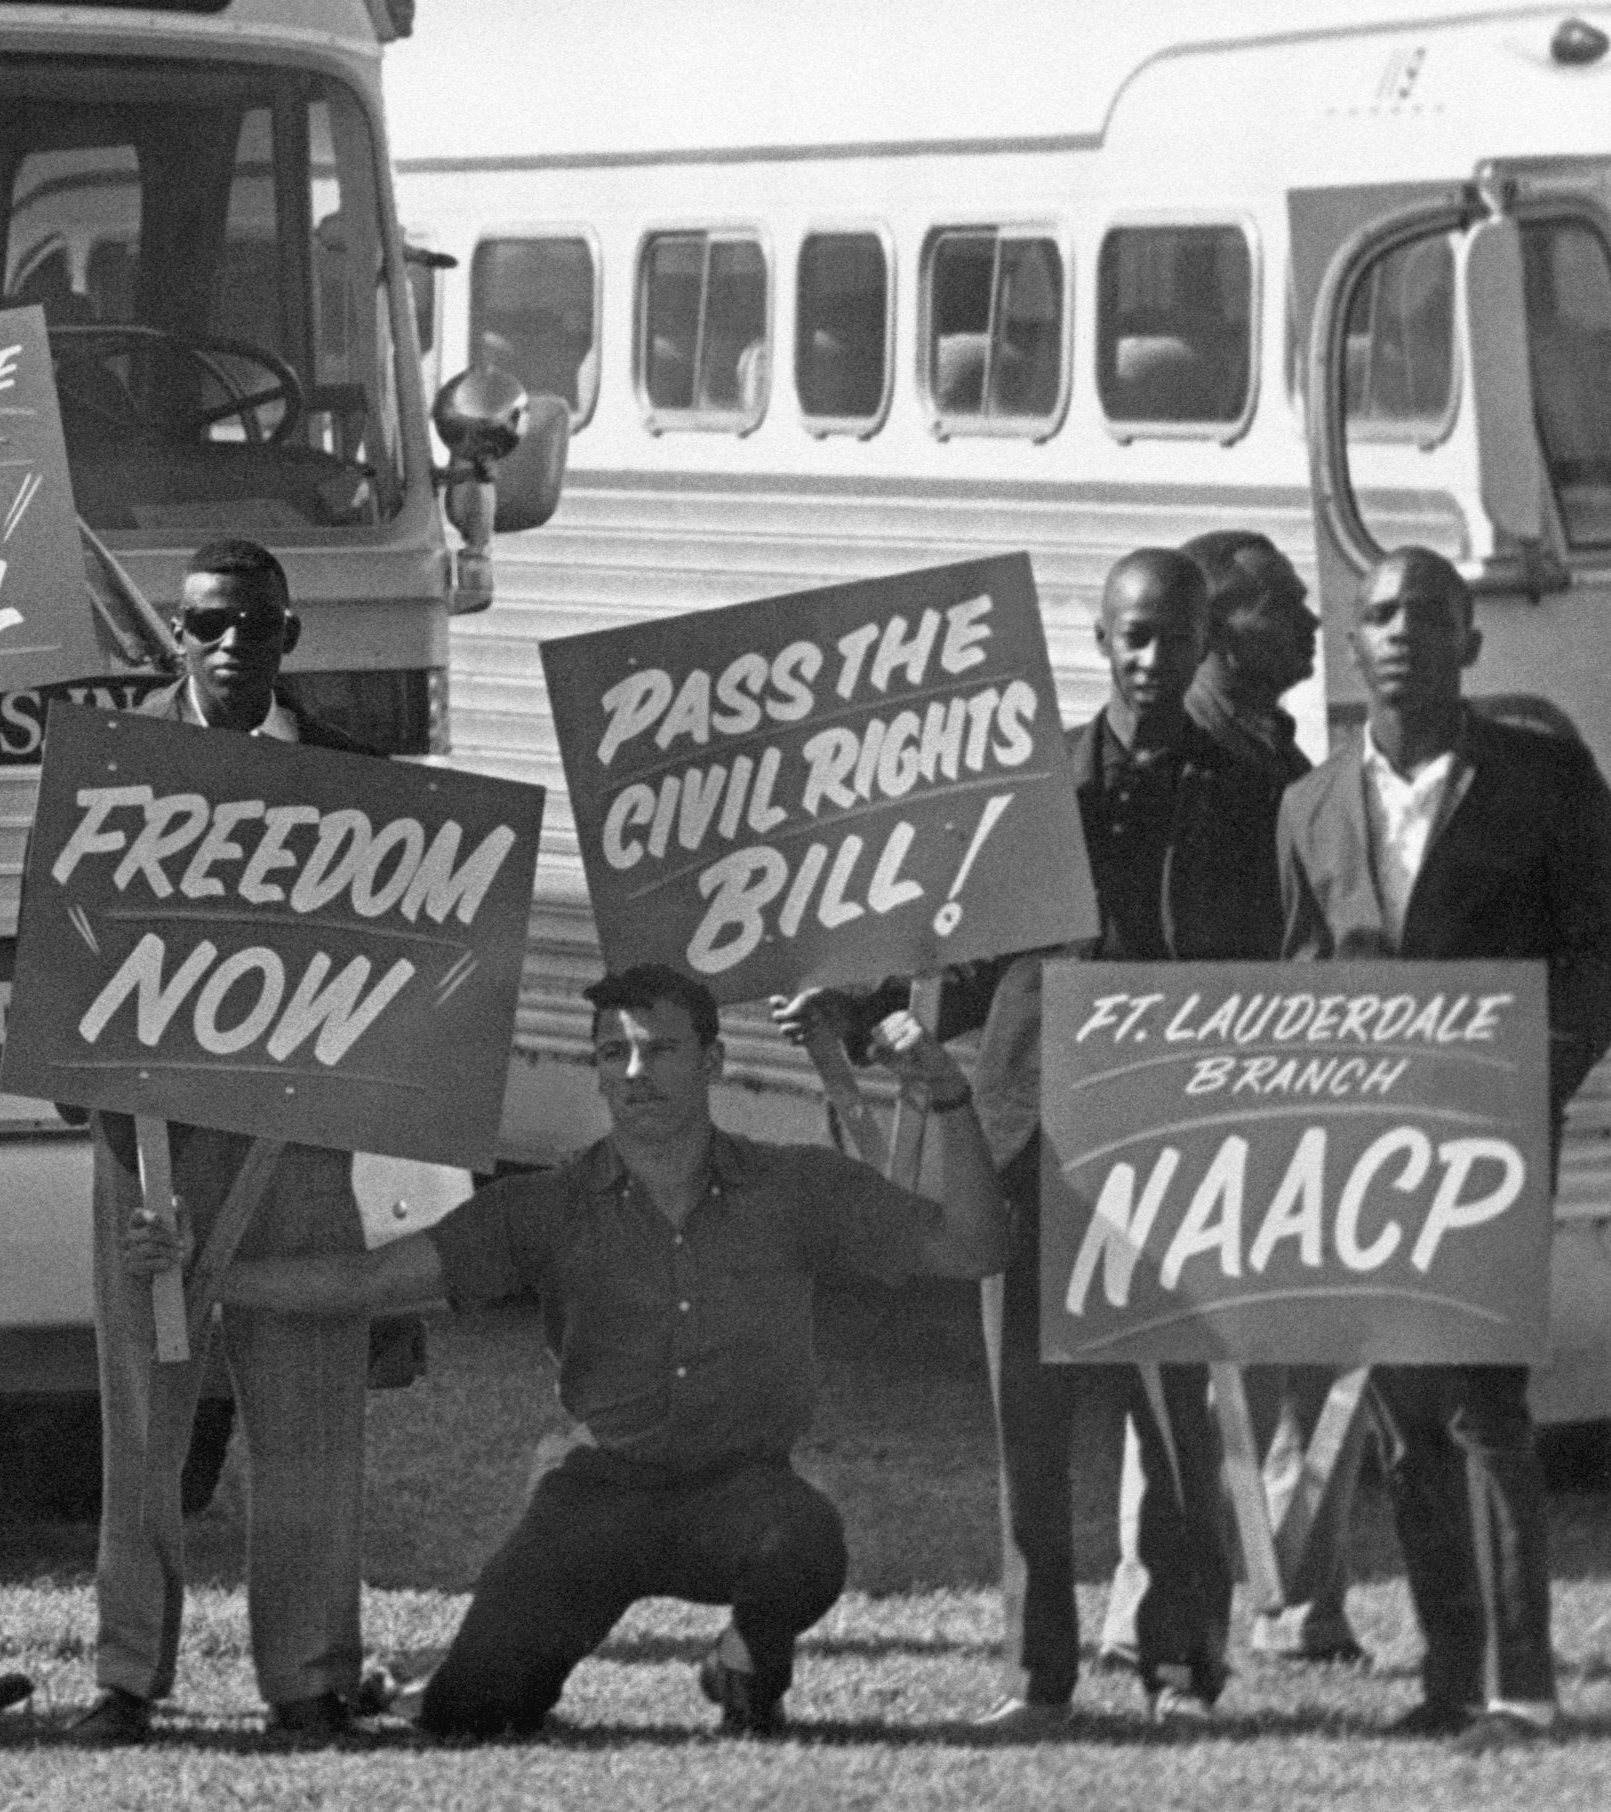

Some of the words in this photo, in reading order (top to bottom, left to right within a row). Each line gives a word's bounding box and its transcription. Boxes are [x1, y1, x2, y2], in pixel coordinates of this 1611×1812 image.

[596, 640, 824, 767] PASS
[836, 594, 993, 700] THE
[602, 746, 788, 870] CIVIL
[801, 680, 1038, 817] RIGHTS
[51, 785, 517, 926] FREEDOM
[78, 932, 416, 1067] NOW
[1075, 991, 1166, 1044] FT.
[1163, 991, 1516, 1045] LAUDERDALE
[1184, 1054, 1414, 1097] BRANCH
[1065, 1125, 1526, 1317] NAACP
